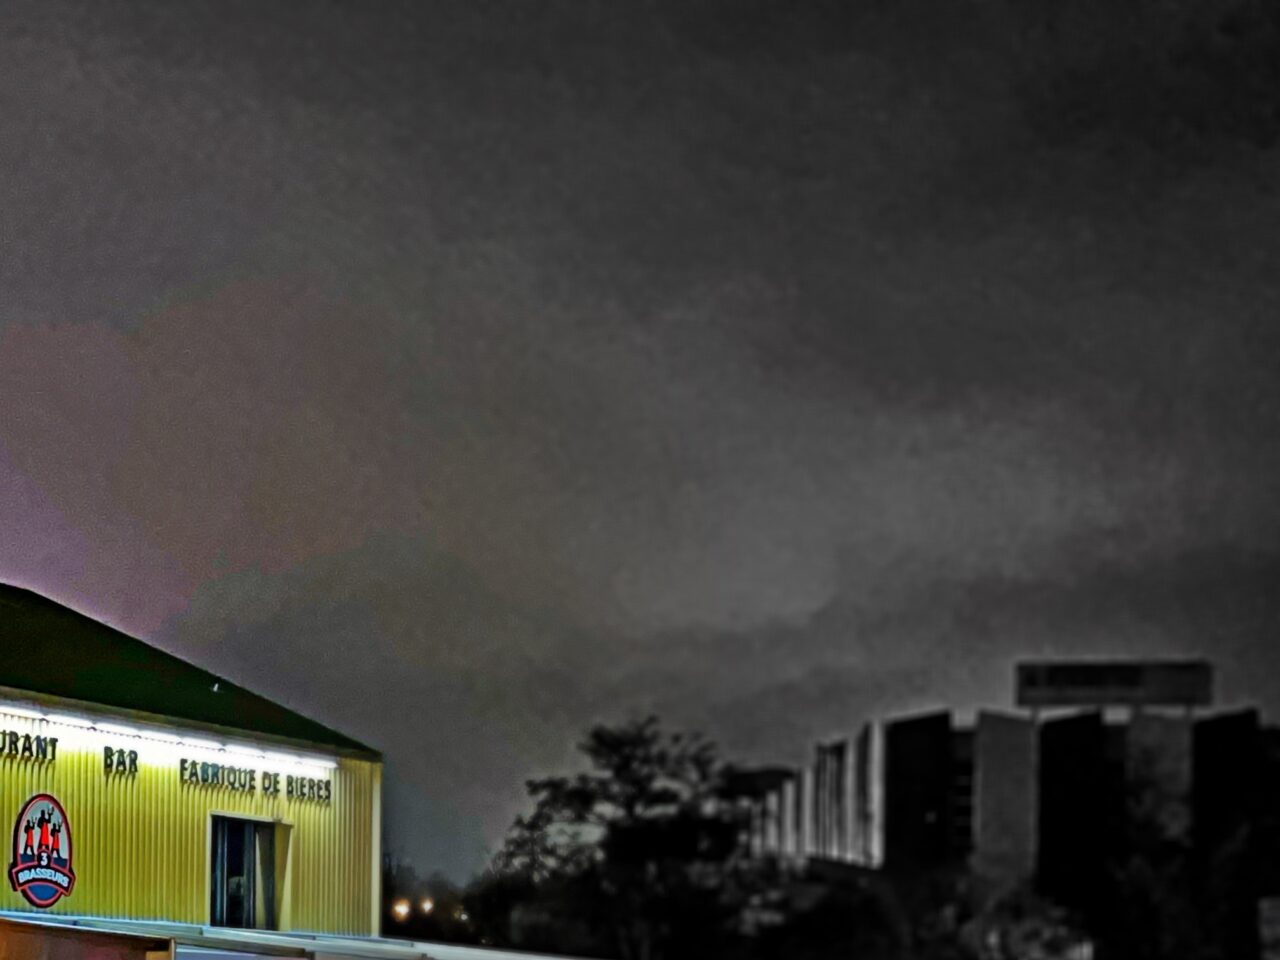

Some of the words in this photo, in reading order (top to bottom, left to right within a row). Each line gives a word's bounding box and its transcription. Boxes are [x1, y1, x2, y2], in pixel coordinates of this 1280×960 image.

[104, 745, 139, 773] BAR
[180, 758, 256, 792] FABRIQUE
[262, 771, 281, 793] DE
[286, 774, 332, 801] BIERES
[40, 852, 48, 866] 3
[17, 867, 70, 888] BRASSEURS
